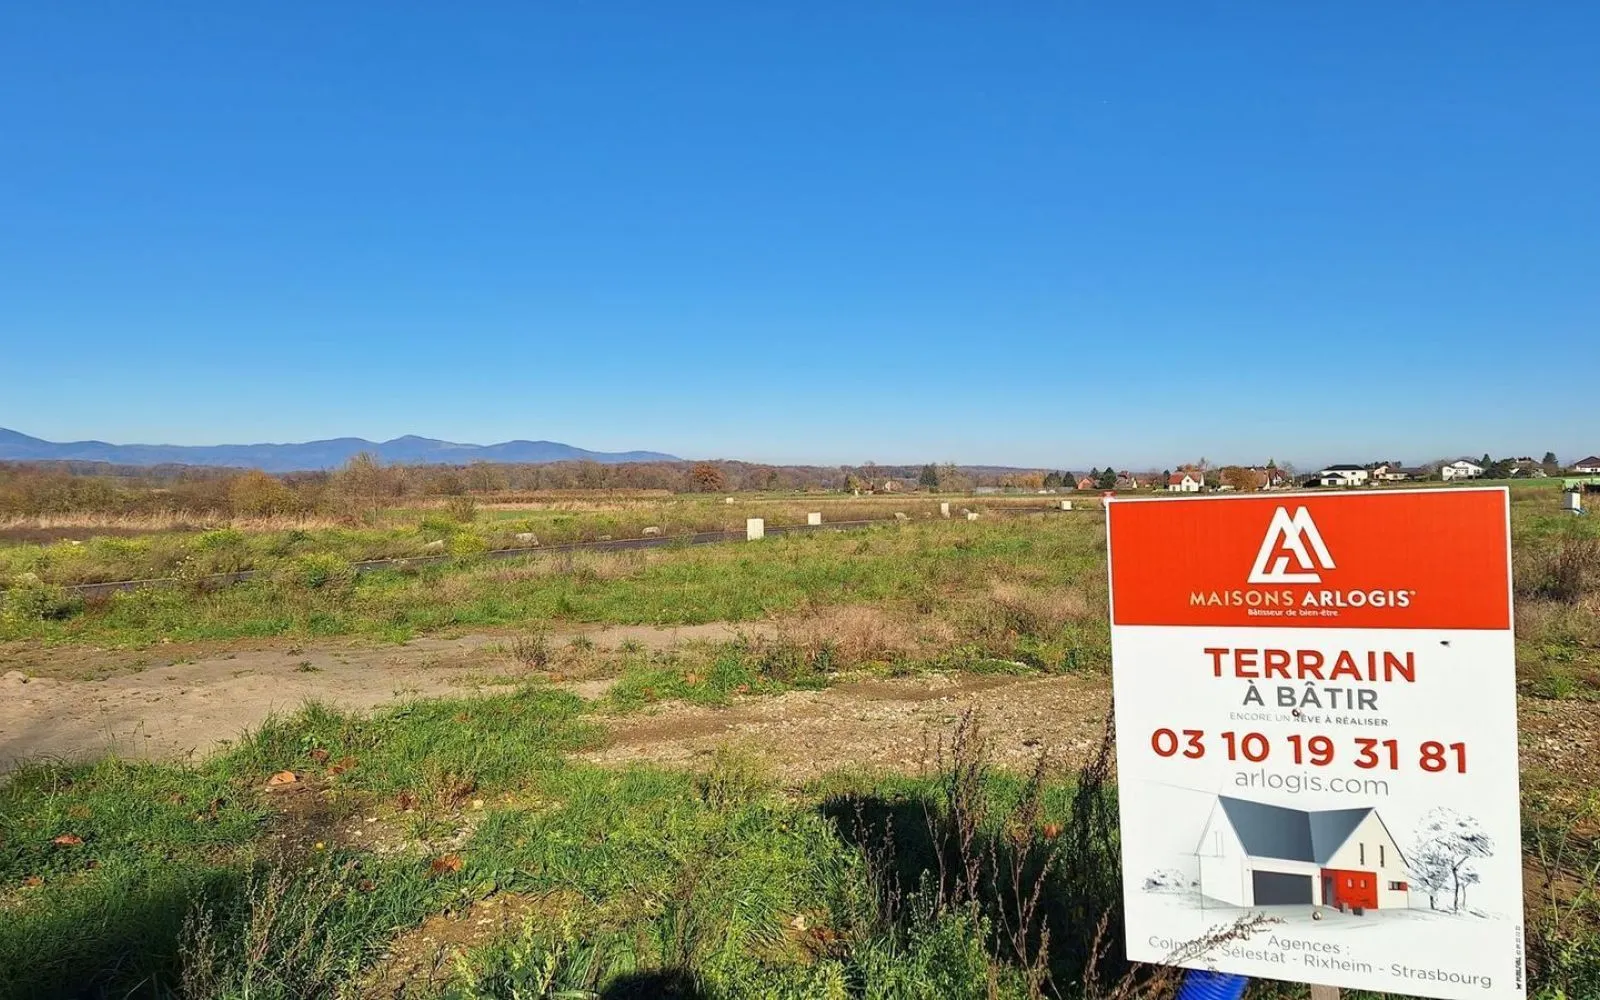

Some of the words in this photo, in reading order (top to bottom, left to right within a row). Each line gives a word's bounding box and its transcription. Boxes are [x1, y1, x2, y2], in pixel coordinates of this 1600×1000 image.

[1189, 591, 1294, 607] MAISONS
[1247, 608, 1283, 617] Bâtisseur
[1285, 608, 1297, 617] de
[1203, 647, 1415, 683] TERRAIN
[1243, 680, 1265, 706] À
[1276, 682, 1378, 711] BÂTIR
[1229, 711, 1272, 722] ENCORE
[1275, 713, 1290, 722] UN
[1325, 715, 1335, 725] À
[1336, 716, 1389, 727] RÉALISER
[1151, 728, 1205, 759] 03
[1221, 731, 1270, 763] 10
[1287, 734, 1335, 766] 19
[1353, 738, 1399, 770] 31
[1419, 741, 1467, 774] 81
[1234, 769, 1389, 797] arlogis.com
[1267, 935, 1340, 955] Agences
[1221, 944, 1287, 964] Sélestat
[1303, 953, 1373, 976] Rixheim
[1390, 963, 1493, 990] Strasbourg
